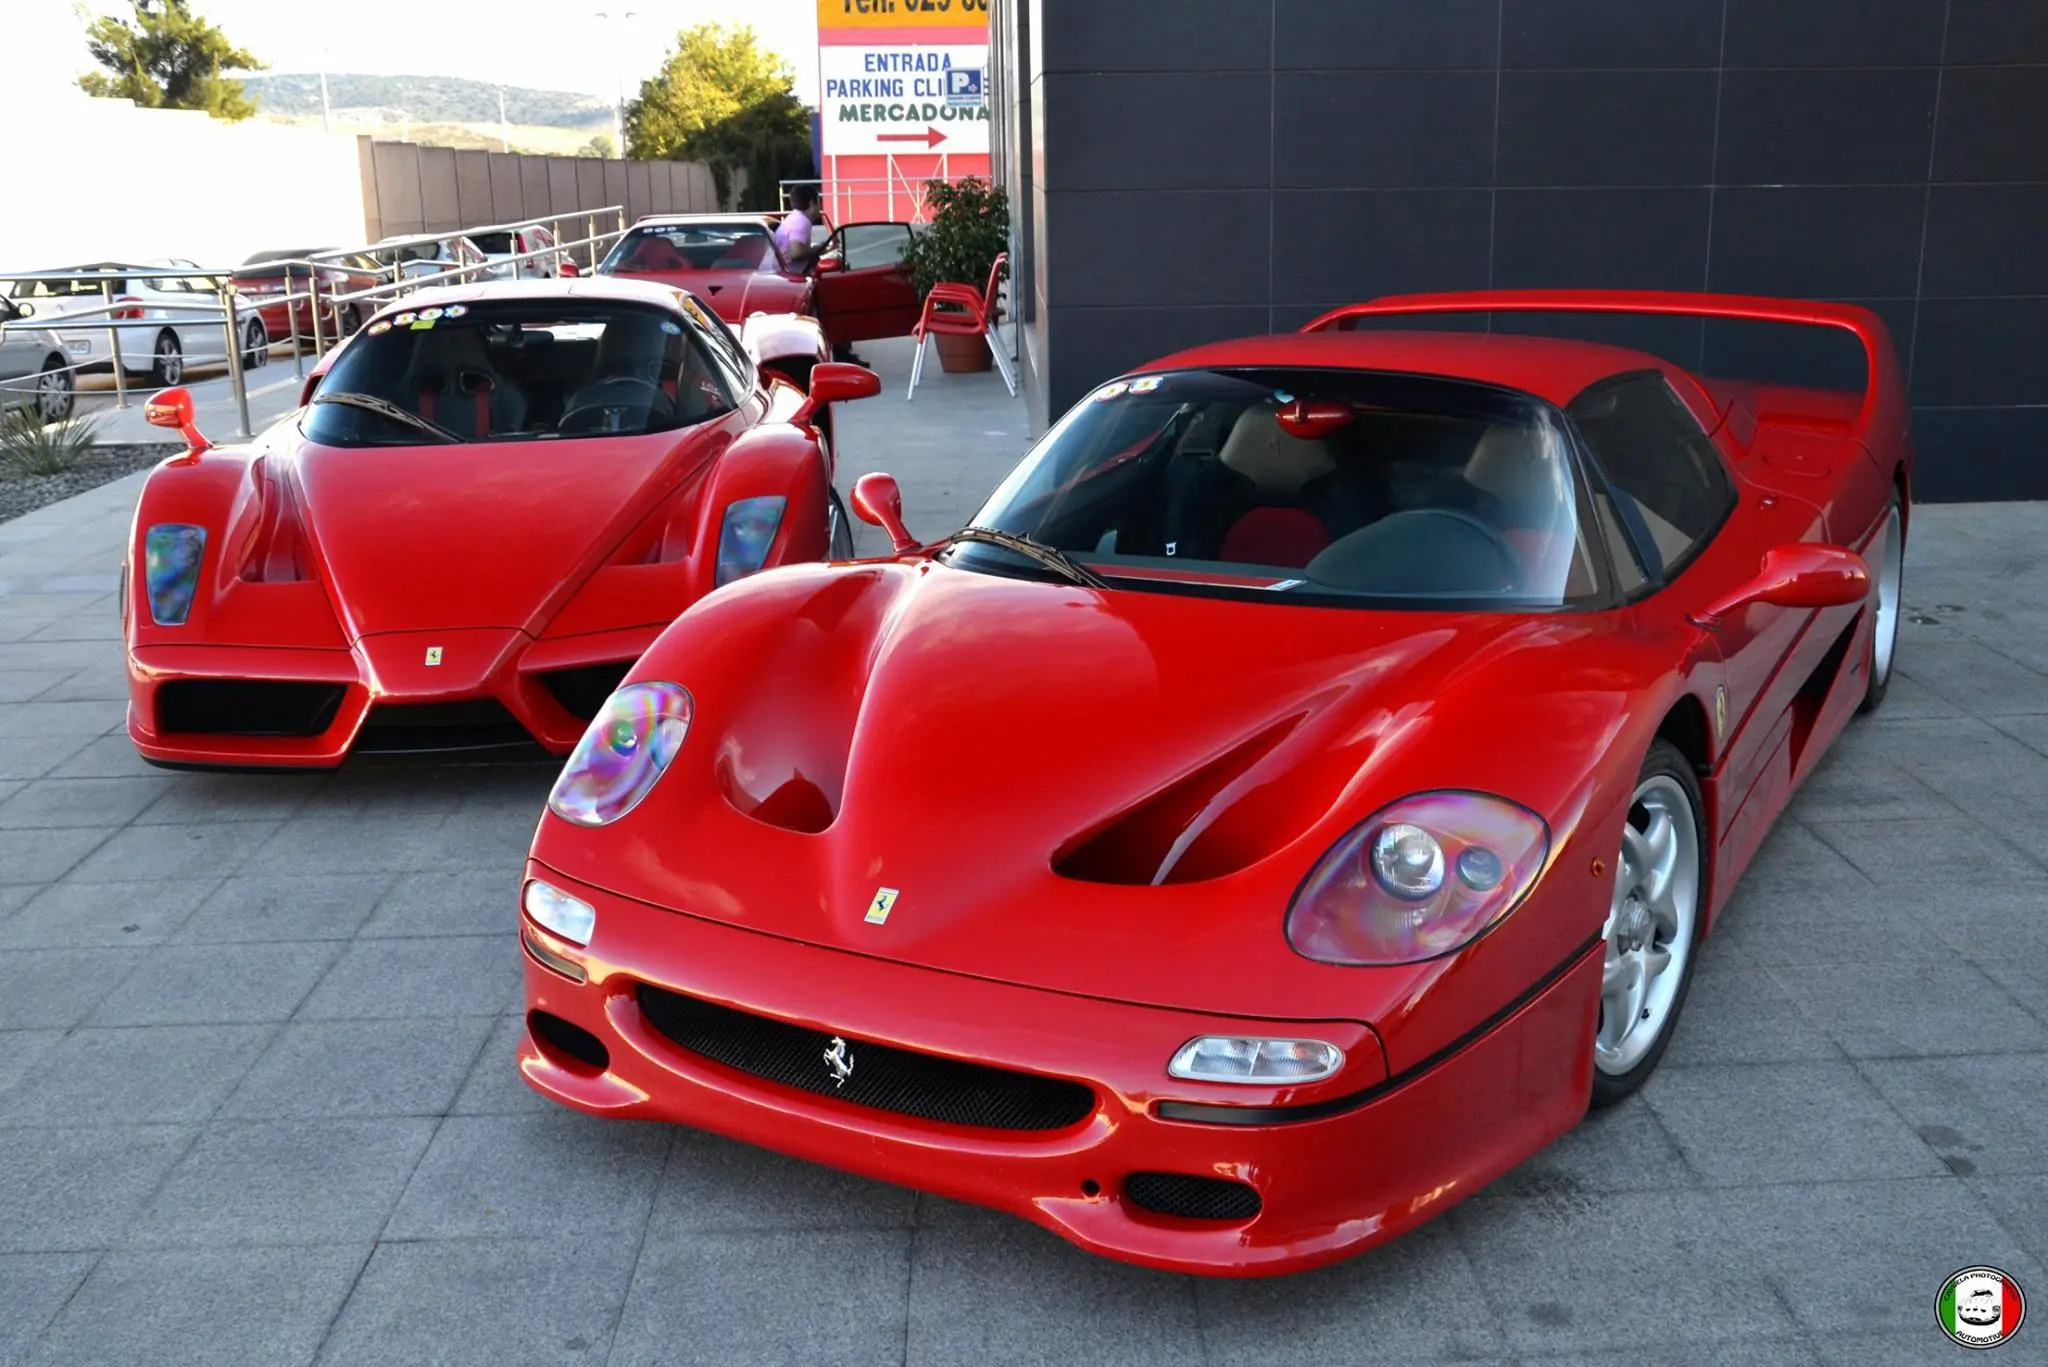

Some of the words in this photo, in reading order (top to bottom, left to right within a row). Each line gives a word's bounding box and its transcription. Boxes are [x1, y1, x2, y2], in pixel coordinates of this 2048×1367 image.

[864, 53, 951, 72] ENTRADA
[826, 78, 904, 98] PARKING
[838, 103, 990, 122] MERCADONA
